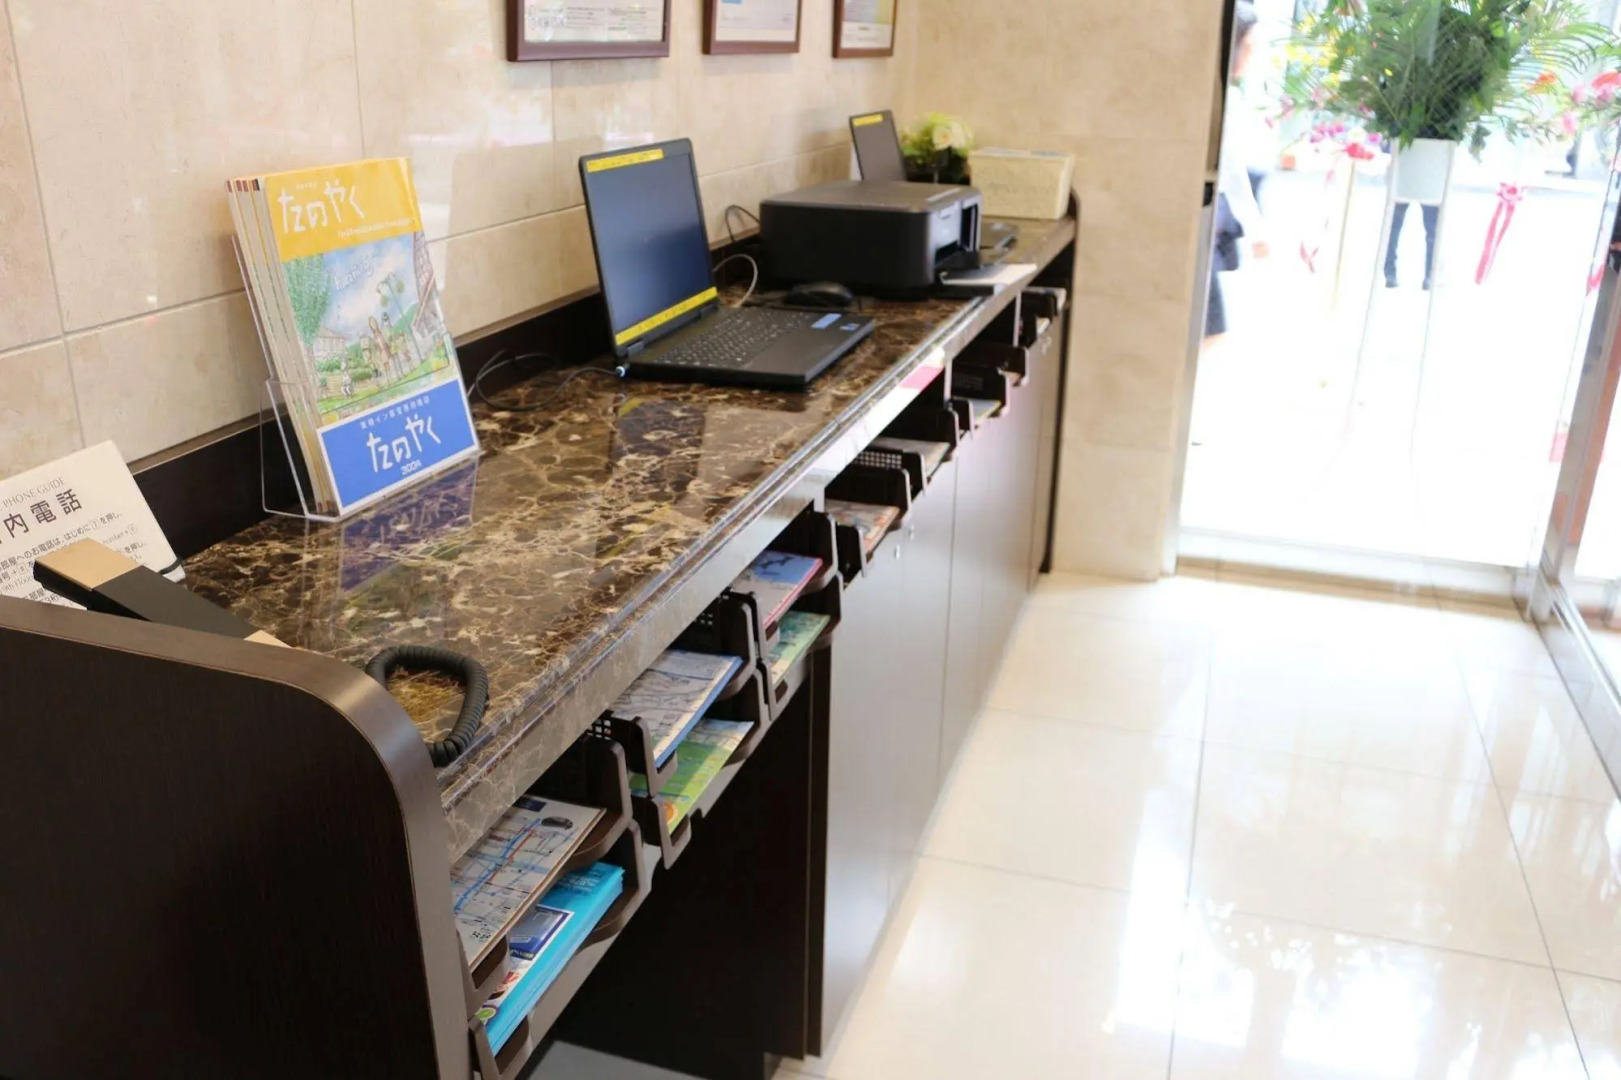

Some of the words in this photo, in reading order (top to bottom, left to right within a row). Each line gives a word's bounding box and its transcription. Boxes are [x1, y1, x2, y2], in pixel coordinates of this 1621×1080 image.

[277, 179, 365, 233] たのやく
[366, 412, 441, 473] たのやく
[0, 489, 82, 544] 内電話
[3, 489, 36, 508] PHONE
[37, 477, 65, 494] GUIDE
